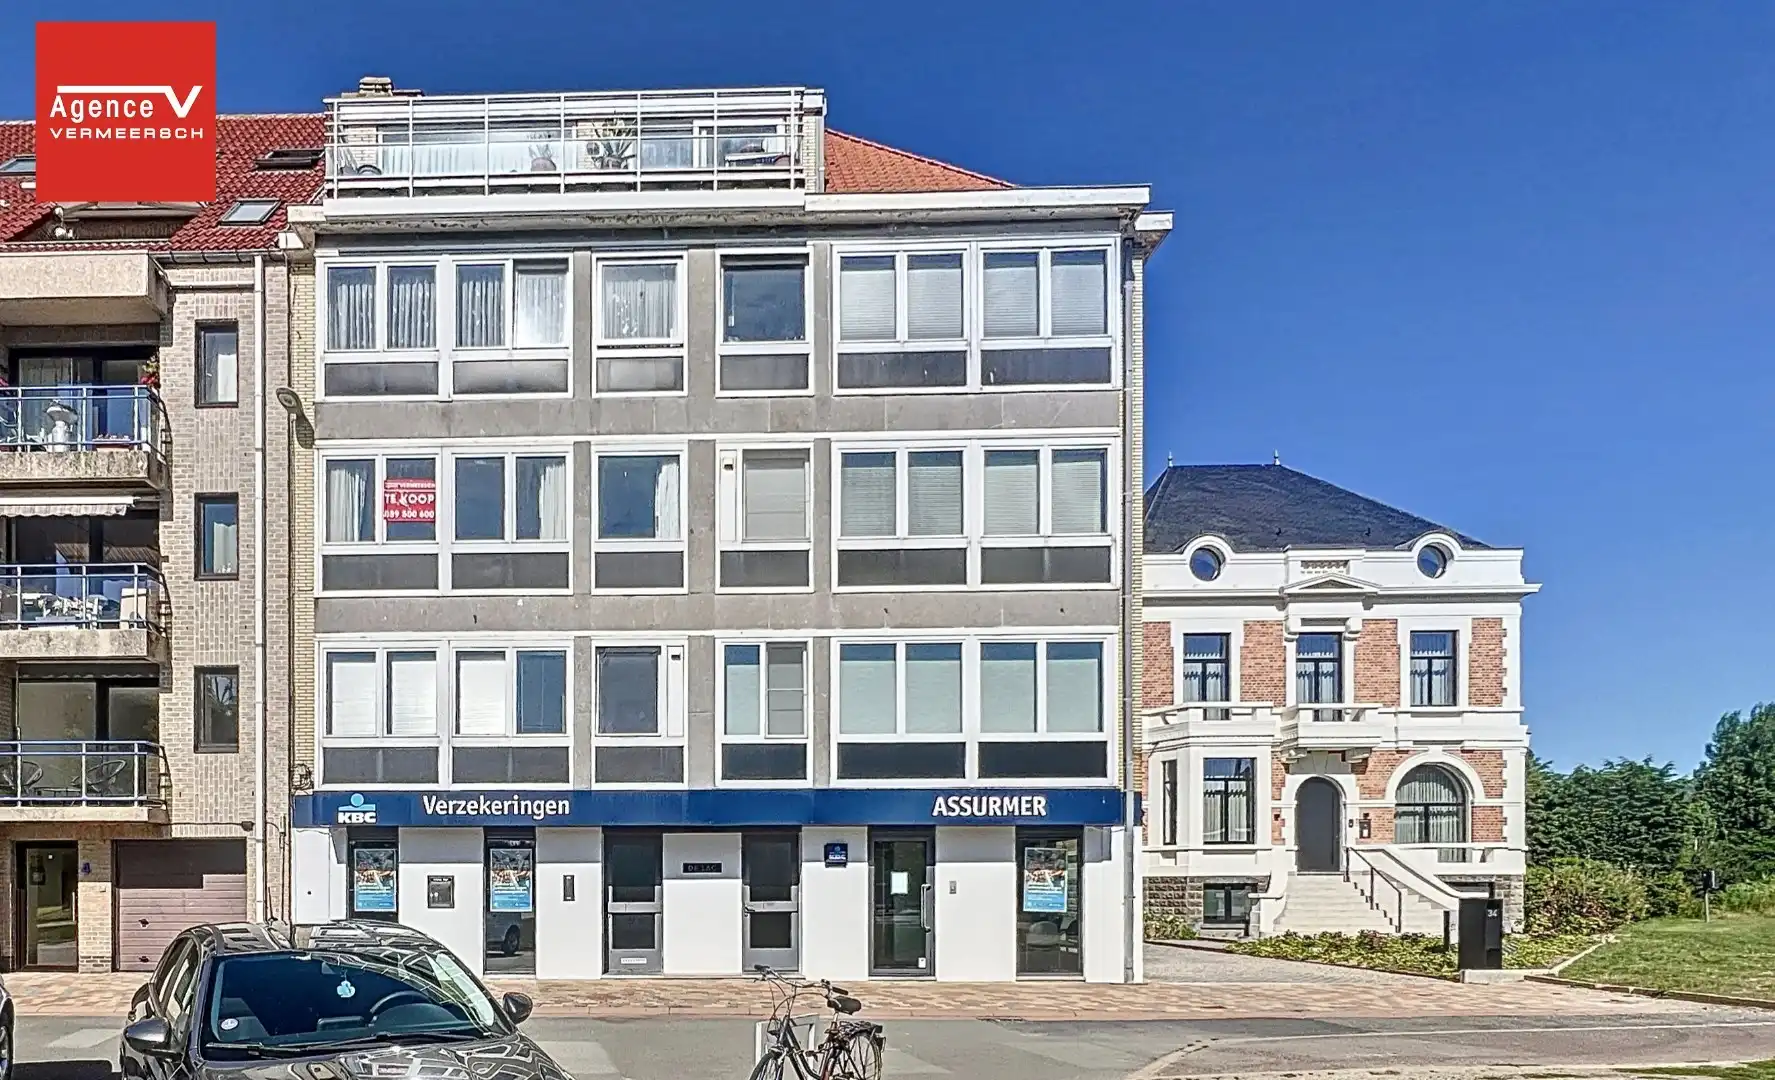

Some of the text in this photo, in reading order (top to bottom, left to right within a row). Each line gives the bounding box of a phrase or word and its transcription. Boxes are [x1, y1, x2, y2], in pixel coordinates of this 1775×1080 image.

[385, 493, 435, 504] TE KOOP
[422, 794, 570, 820] Verzekeringen
[932, 795, 1047, 817] ASSURMER
[338, 812, 377, 824] KBC
[1487, 909, 1498, 917] 34
